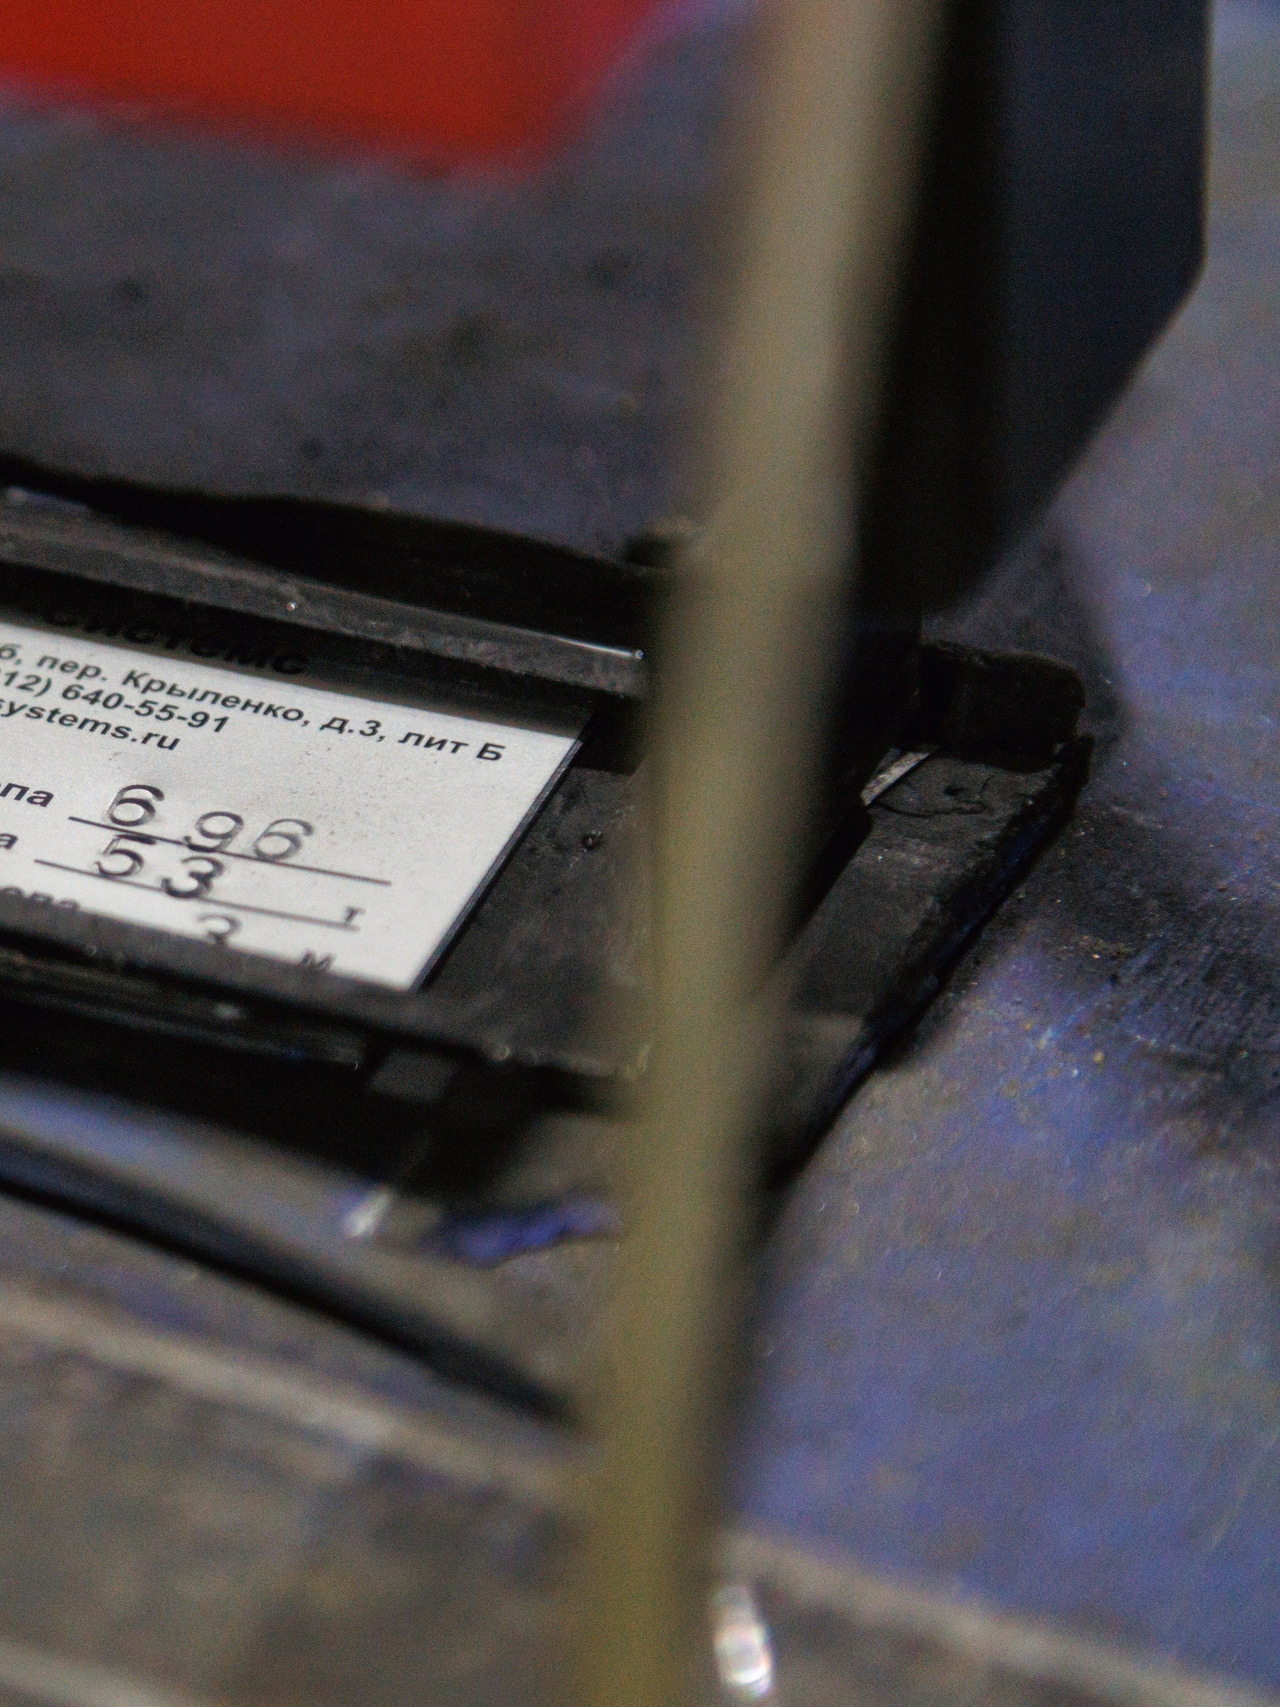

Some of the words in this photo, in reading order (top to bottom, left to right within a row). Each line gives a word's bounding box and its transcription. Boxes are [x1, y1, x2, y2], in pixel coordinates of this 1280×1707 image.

[37, 655, 108, 681] пер.
[122, 669, 310, 727] Крыленко,
[320, 717, 385, 742] д.3,
[398, 731, 469, 754] лит
[476, 742, 507, 761] Б
[61, 684, 230, 733] 640-55-91
[94, 833, 225, 899] 53
